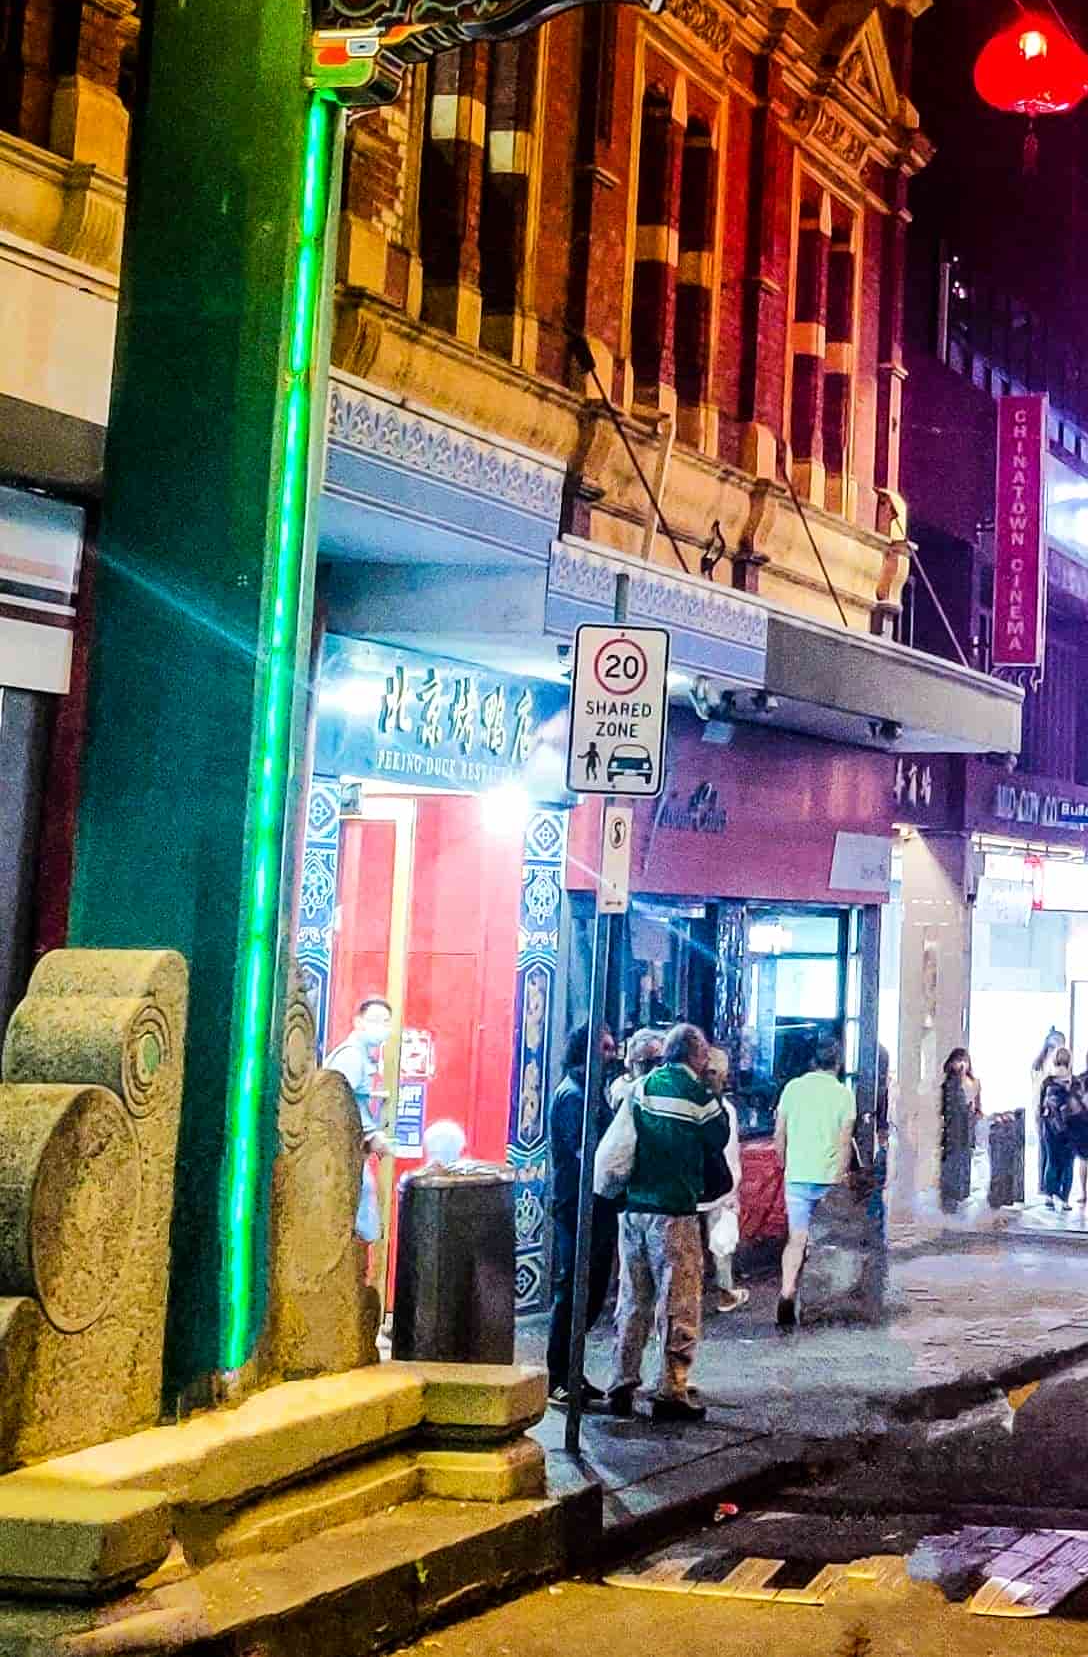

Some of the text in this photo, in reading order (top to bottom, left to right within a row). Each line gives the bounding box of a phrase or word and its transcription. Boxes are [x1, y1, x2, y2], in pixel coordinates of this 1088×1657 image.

[1006, 408, 1028, 651] CHINATOWN CINEMA
[604, 654, 639, 680] 20
[585, 700, 652, 719] SHARED
[595, 721, 639, 739] ZONE
